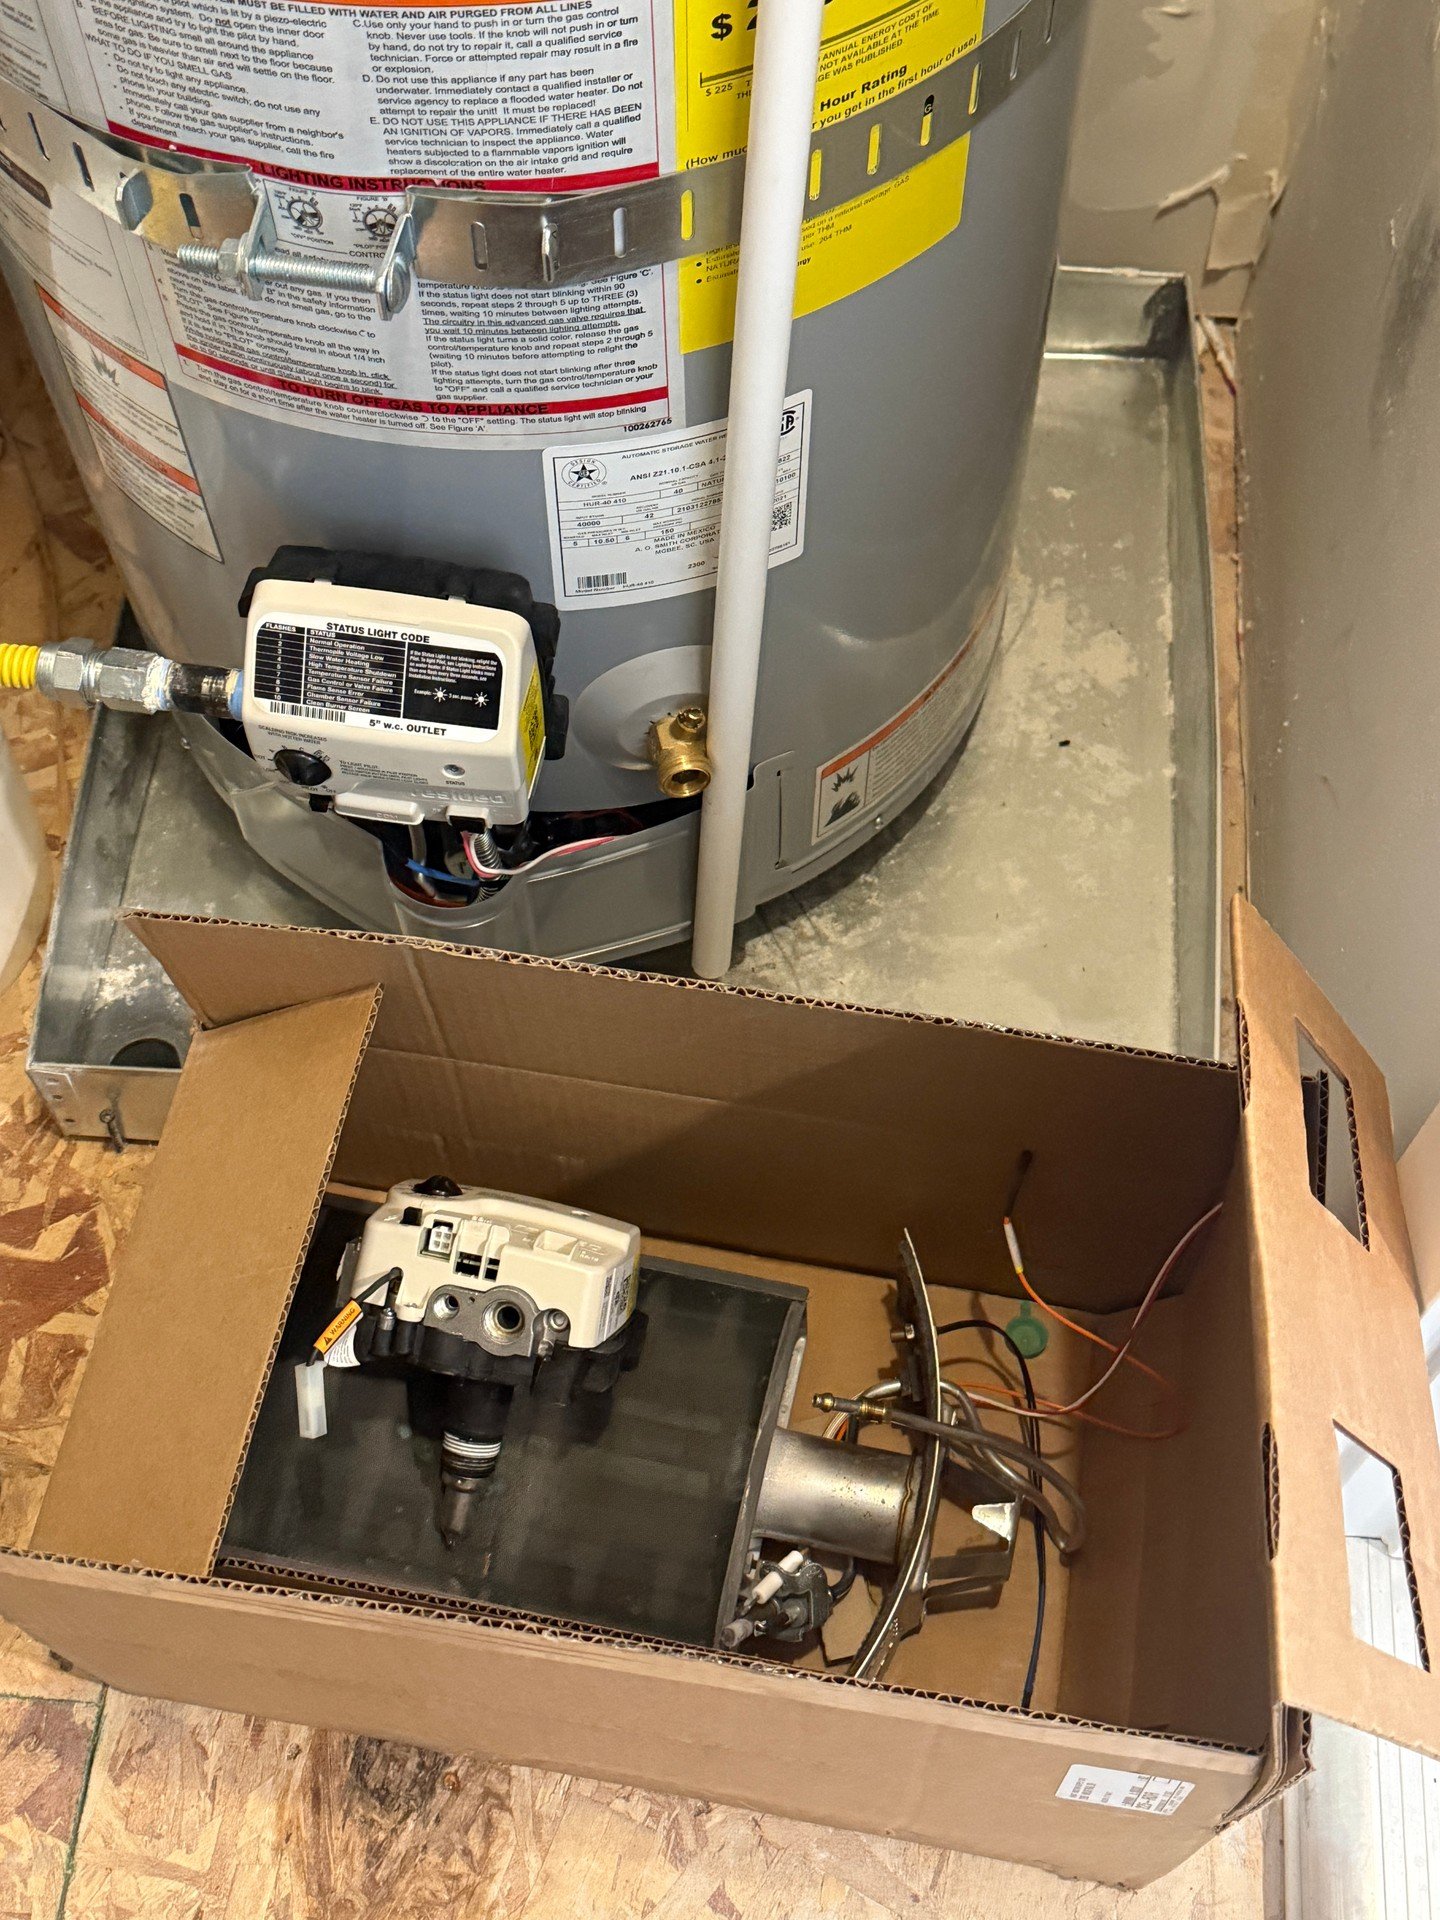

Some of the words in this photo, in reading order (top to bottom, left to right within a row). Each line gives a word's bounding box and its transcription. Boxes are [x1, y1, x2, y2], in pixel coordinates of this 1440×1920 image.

[271, 2, 286, 11] BE
[288, 5, 325, 15] FILLED
[328, 8, 356, 18] WITH
[360, 10, 398, 18] WATER
[401, 11, 425, 19] AND
[450, 9, 497, 18] PURGED
[500, 6, 533, 16] FROM
[535, 3, 558, 14] ALL
[560, 0, 592, 12] LINES
[711, 13, 733, 41] $
[823, 41, 858, 60] ANNUAL
[861, 22, 898, 43] ENERGY
[899, 10, 921, 26] COST
[923, 3, 933, 14] OF
[819, 59, 838, 72] NOT
[841, 36, 889, 63] AVAILABLE
[891, 30, 902, 41] AT
[904, 21, 919, 33] THE
[922, 9, 940, 23] TIME
[833, 64, 853, 76] WAS
[855, 38, 903, 67] PUBLISHED
[715, 82, 733, 95] 225
[819, 111, 841, 129] you
[844, 102, 862, 119] get
[865, 95, 875, 106] in
[878, 87, 895, 100] the
[897, 74, 918, 91] first
[920, 60, 944, 76] hour
[945, 48, 956, 61] of
[957, 33, 977, 54] use)
[820, 89, 857, 112] Hour
[861, 65, 907, 93] Rating
[369, 117, 380, 125] E.
[383, 117, 399, 125] DO
[427, 118, 448, 126] USE
[451, 118, 475, 126] THIS
[478, 116, 536, 126] APPLIANCE
[540, 115, 549, 123] IF
[551, 111, 588, 122] THERE
[590, 108, 611, 118] HAS
[614, 103, 642, 114] BEEN
[686, 153, 718, 170] (How
[722, 146, 748, 159] muc
[261, 163, 343, 188] LIGHTING
[279, 380, 299, 392] TO
[303, 384, 346, 401] TURN
[353, 394, 382, 407] OFF
[389, 399, 421, 412] GAS
[428, 403, 449, 413] TO
[454, 403, 548, 415] APPLIANCE
[564, 413, 581, 422] light
[598, 410, 614, 418] stop
[616, 405, 646, 416] blinking
[623, 418, 672, 432] 100262765
[622, 450, 660, 459] AUTOMATIC
[662, 442, 693, 453] STORAGE
[695, 436, 717, 445] WATER
[654, 535, 675, 543] MADE
[687, 526, 715, 536] MEXICO
[655, 541, 677, 549] SMITH
[680, 530, 721, 543] CORPORAT
[688, 561, 705, 569] 2300
[265, 623, 296, 632] FLASHES
[310, 630, 336, 638] STATUS
[326, 622, 365, 634] STATUS
[368, 628, 398, 639] LIGHT
[400, 632, 430, 643] CODE
[310, 638, 332, 646] Normal
[334, 640, 365, 650] Operation
[310, 646, 344, 655] Thermopile
[345, 650, 369, 659] Voltage
[324, 663, 363, 674] Temperature
[364, 667, 396, 678] Shutdown
[345, 658, 370, 668] Heating
[308, 669, 347, 679] Temperature
[348, 674, 370, 682] Sensor
[307, 684, 326, 692] Flame
[321, 678, 344, 686] Control
[372, 685, 393, 693] Failure
[307, 692, 335, 700] Chamber
[360, 698, 381, 707] Failure
[325, 702, 346, 710] Burner
[348, 705, 370, 713] Screen
[369, 719, 381, 727] 5"
[384, 722, 403, 731] w.c.
[406, 724, 446, 736] OUTLET
[330, 1308, 355, 1335] WARNING
